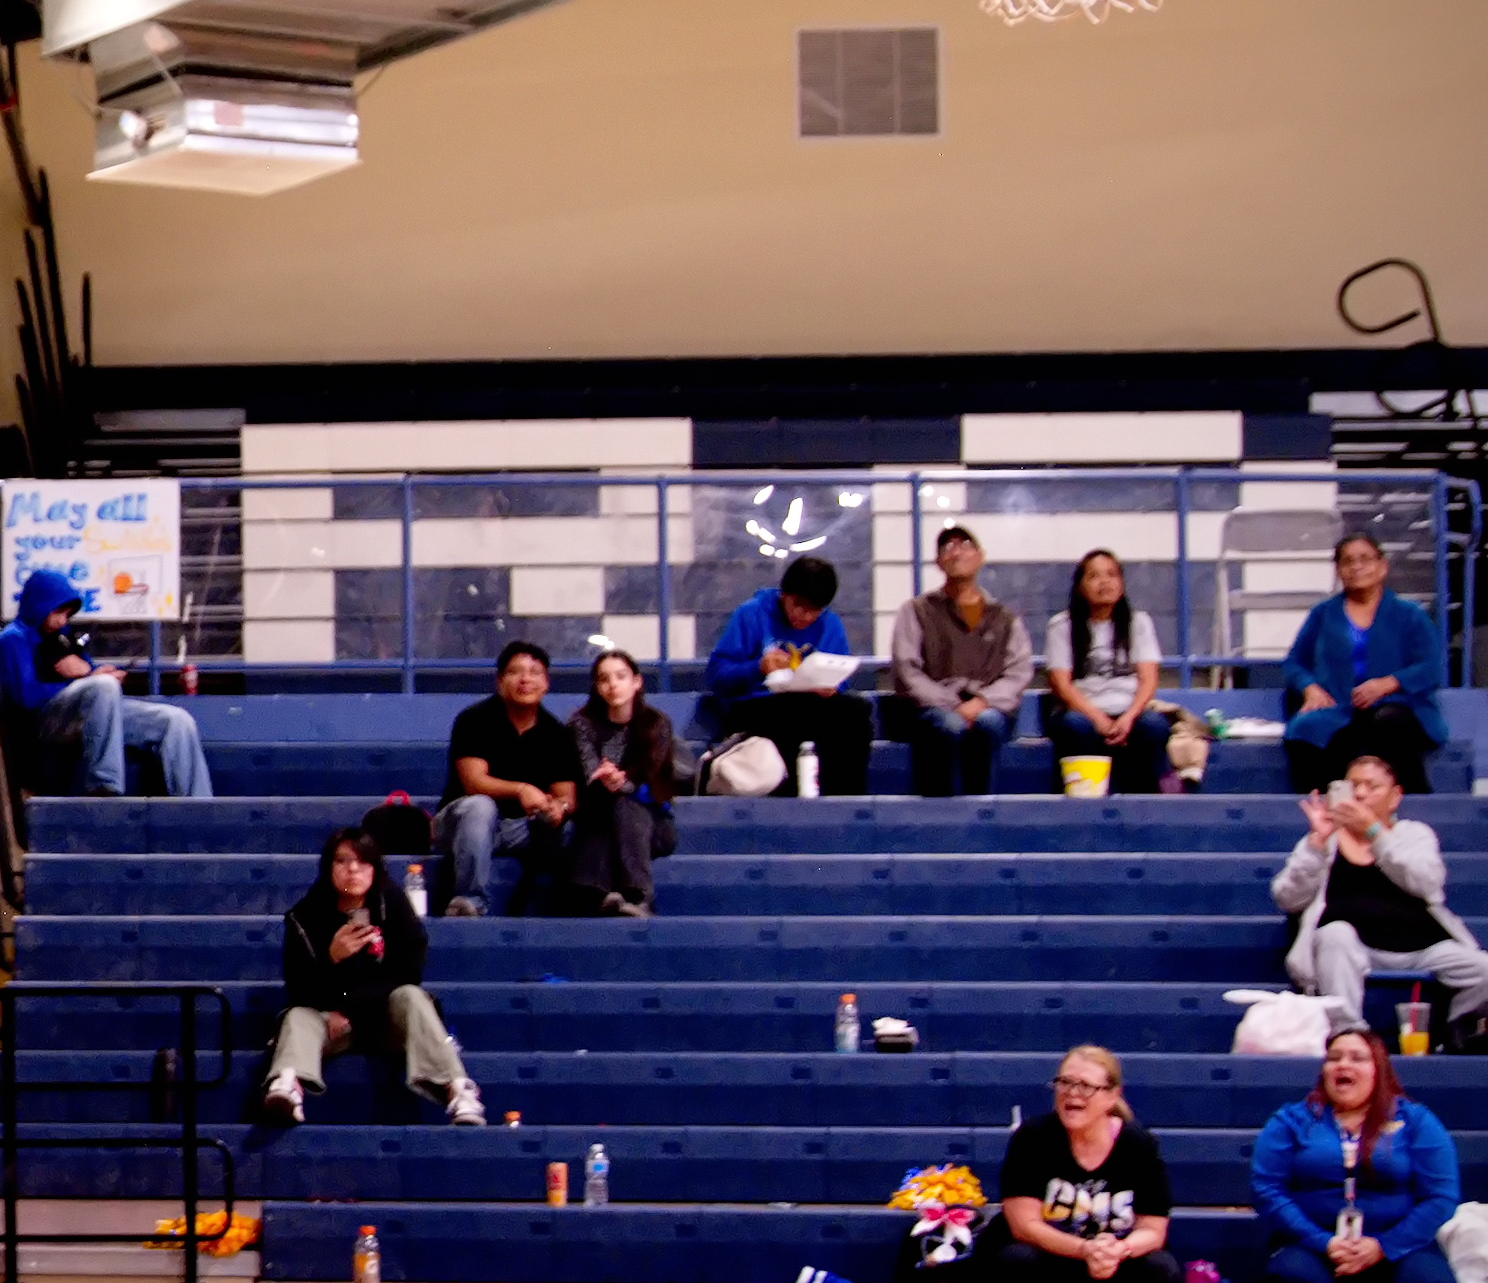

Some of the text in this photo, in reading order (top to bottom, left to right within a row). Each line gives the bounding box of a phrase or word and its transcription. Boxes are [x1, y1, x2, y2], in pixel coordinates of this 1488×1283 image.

[5, 491, 149, 530] May all
[14, 535, 81, 562] your
